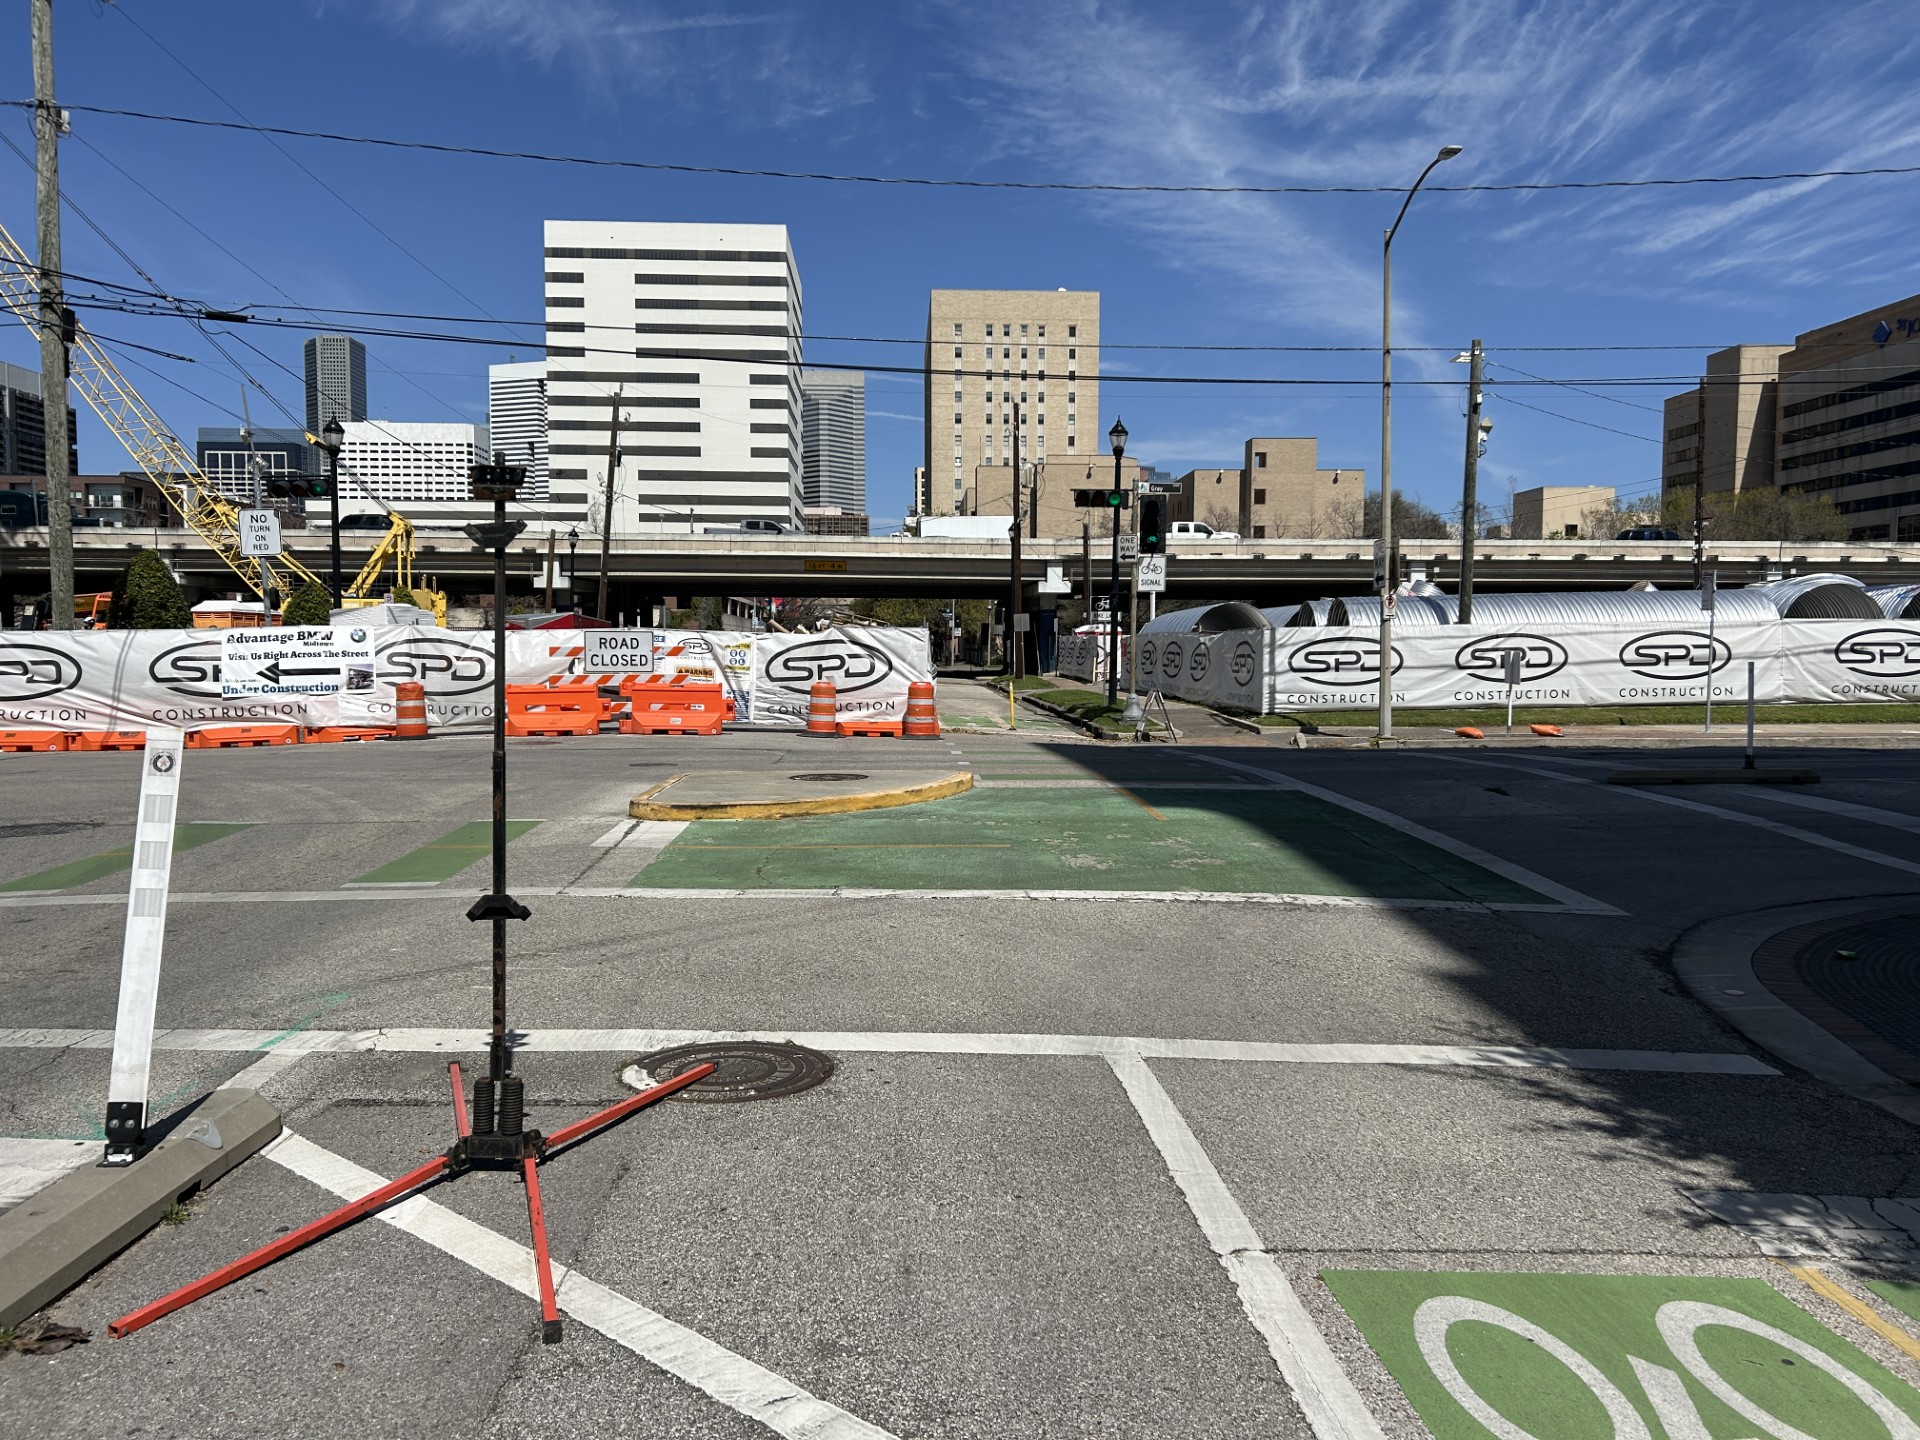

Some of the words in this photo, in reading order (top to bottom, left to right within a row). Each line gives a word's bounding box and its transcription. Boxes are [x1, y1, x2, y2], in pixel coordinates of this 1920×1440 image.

[250, 514, 267, 523] NO
[226, 632, 294, 644] Advantage
[297, 631, 334, 641] BMW
[598, 637, 640, 650] ROAD
[250, 652, 262, 660] Us
[263, 651, 289, 661] Right
[290, 651, 322, 659] Across
[323, 650, 340, 658] The
[341, 650, 369, 658] Street
[590, 653, 649, 667] CLOSED
[1633, 644, 1717, 666] SPD
[781, 653, 876, 681] SPD
[222, 685, 260, 694] Under
[261, 683, 339, 693] Construction
[1619, 686, 1733, 698] CONSTRUCTON
[1287, 693, 1405, 704] CONSTRUCTN
[152, 703, 308, 721] CONSTRUCTION
[367, 703, 493, 717] CORUCTIO
[766, 700, 896, 714] CONSUCTION
[0, 709, 87, 721] RUCTION
